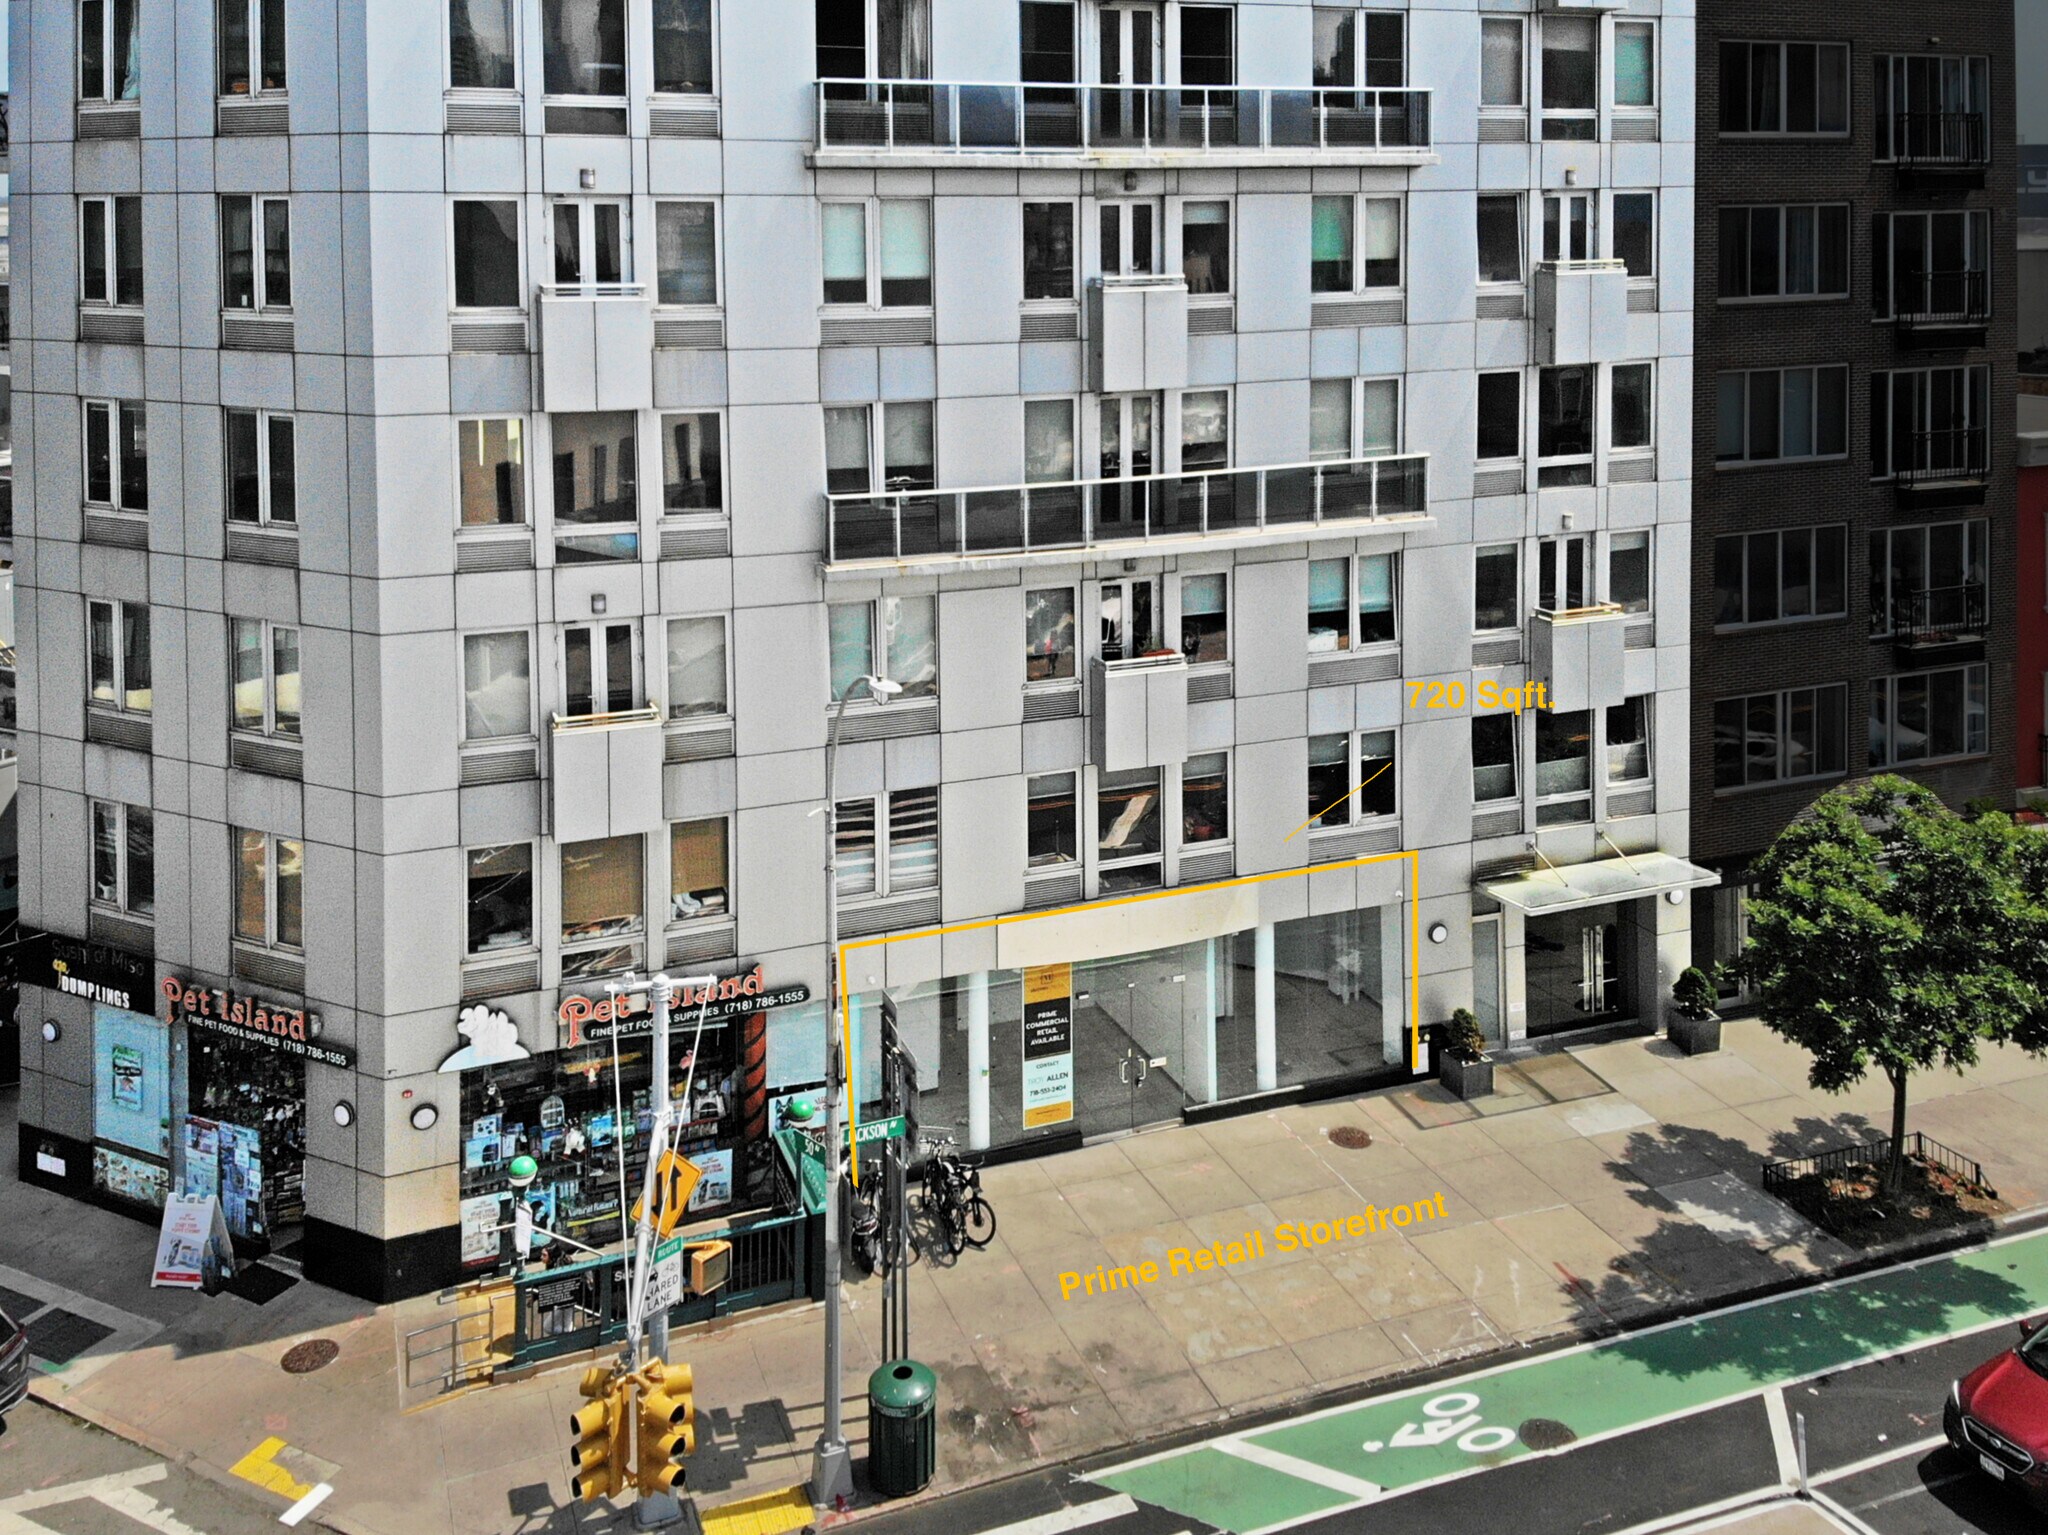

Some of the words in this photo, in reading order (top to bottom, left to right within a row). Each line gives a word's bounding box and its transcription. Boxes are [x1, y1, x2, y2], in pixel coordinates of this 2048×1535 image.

[61, 975, 130, 1009] DUMPLINGS
[160, 977, 210, 1025] Pet
[221, 992, 306, 1041] Island
[559, 992, 632, 1048] Pet
[648, 963, 765, 1013] sland
[590, 1026, 614, 1038] FINE
[616, 1022, 635, 1033] PET
[636, 1018, 654, 1030] FOO
[673, 1006, 719, 1022] SUPPIES
[724, 1000, 753, 1014] (718)
[755, 990, 804, 1008] 786-1555
[1037, 1010, 1058, 1019] PRIME
[1025, 1017, 1069, 1030] COMMERCIAL
[1036, 1027, 1059, 1036] RETAIL
[188, 1014, 204, 1027] FINE
[204, 1018, 217, 1030] PET
[218, 1022, 239, 1036] FOOD
[239, 1028, 245, 1038] &
[245, 1030, 280, 1047] SUPPLIES
[283, 1039, 306, 1055] (718)
[306, 1045, 347, 1067] 786-1555
[1030, 1034, 1065, 1046] AVAILABLE
[1036, 1060, 1059, 1070] CONTACT
[1046, 1072, 1069, 1082] ALLEN
[844, 1122, 888, 1145] JCKSON
[805, 1138, 814, 1156] 50
[646, 1274, 679, 1300] HARED
[648, 1290, 673, 1312] LANE
